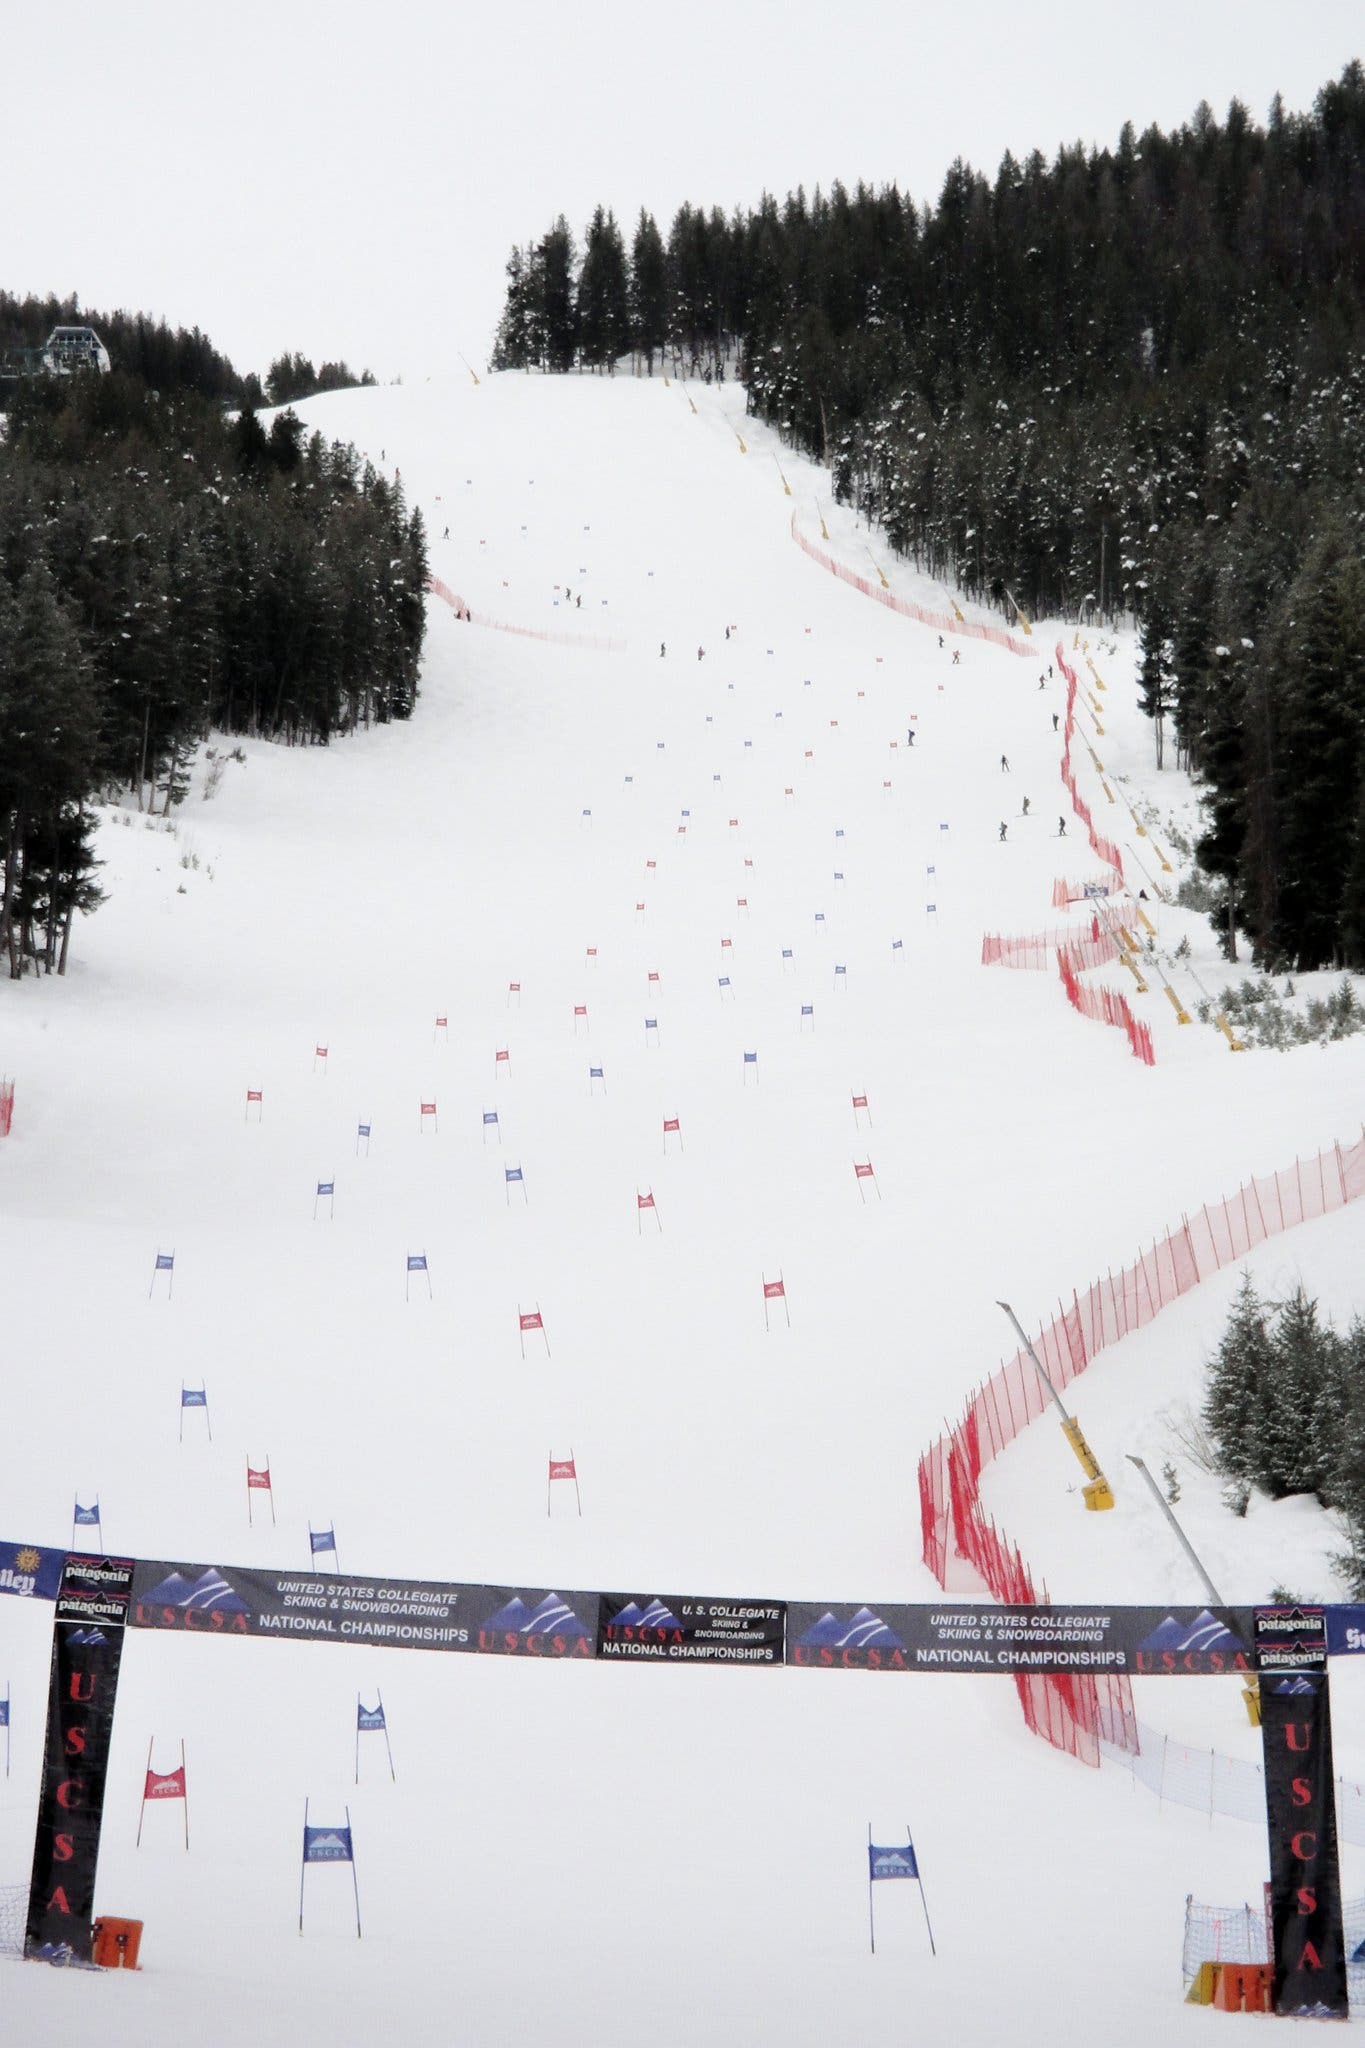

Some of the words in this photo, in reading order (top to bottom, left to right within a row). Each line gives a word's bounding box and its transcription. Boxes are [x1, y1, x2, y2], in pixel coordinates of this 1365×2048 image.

[65, 1567, 129, 1582] patagonia
[277, 1581, 324, 1595] UNITED
[327, 1584, 375, 1599] STATES
[378, 1588, 458, 1605] COLLEGIATE
[58, 1600, 124, 1615] patagonia
[283, 1595, 327, 1609] SKIING
[330, 1599, 339, 1609] &
[342, 1599, 449, 1617] SNOWBOARDING
[682, 1605, 693, 1615] U.
[696, 1606, 706, 1616] S.
[709, 1606, 779, 1620] COLLEGIATE
[136, 1604, 248, 1630] USCSA
[712, 1619, 741, 1629] SKIING
[742, 1621, 748, 1629] &
[930, 1614, 976, 1626] UNITED
[979, 1615, 1028, 1627] STATES
[1031, 1616, 1111, 1628] COLLEGIATE
[1258, 1619, 1322, 1631] patagonia
[259, 1614, 336, 1632] NATIONAL
[340, 1621, 469, 1643] CHAMPIONSHIPS
[606, 1625, 683, 1644] USCSA
[694, 1629, 765, 1641] SNOWBOARDING
[938, 1628, 982, 1640] SKIING
[984, 1629, 993, 1640] &
[996, 1629, 1104, 1641] SNOWBOARDING
[477, 1630, 591, 1655] USCSA
[602, 1642, 666, 1656] NATIONAL
[669, 1645, 773, 1660] CHAMPIONSHIPS
[794, 1647, 907, 1670] USCSA
[916, 1649, 994, 1664] NATIONAL
[997, 1650, 1126, 1665] CHAMPIONSHIPS
[1135, 1651, 1248, 1670] USCSA
[1260, 1652, 1324, 1666] patagonia
[46, 1672, 97, 1915] USCSA
[1284, 1723, 1324, 1970] USCSA
